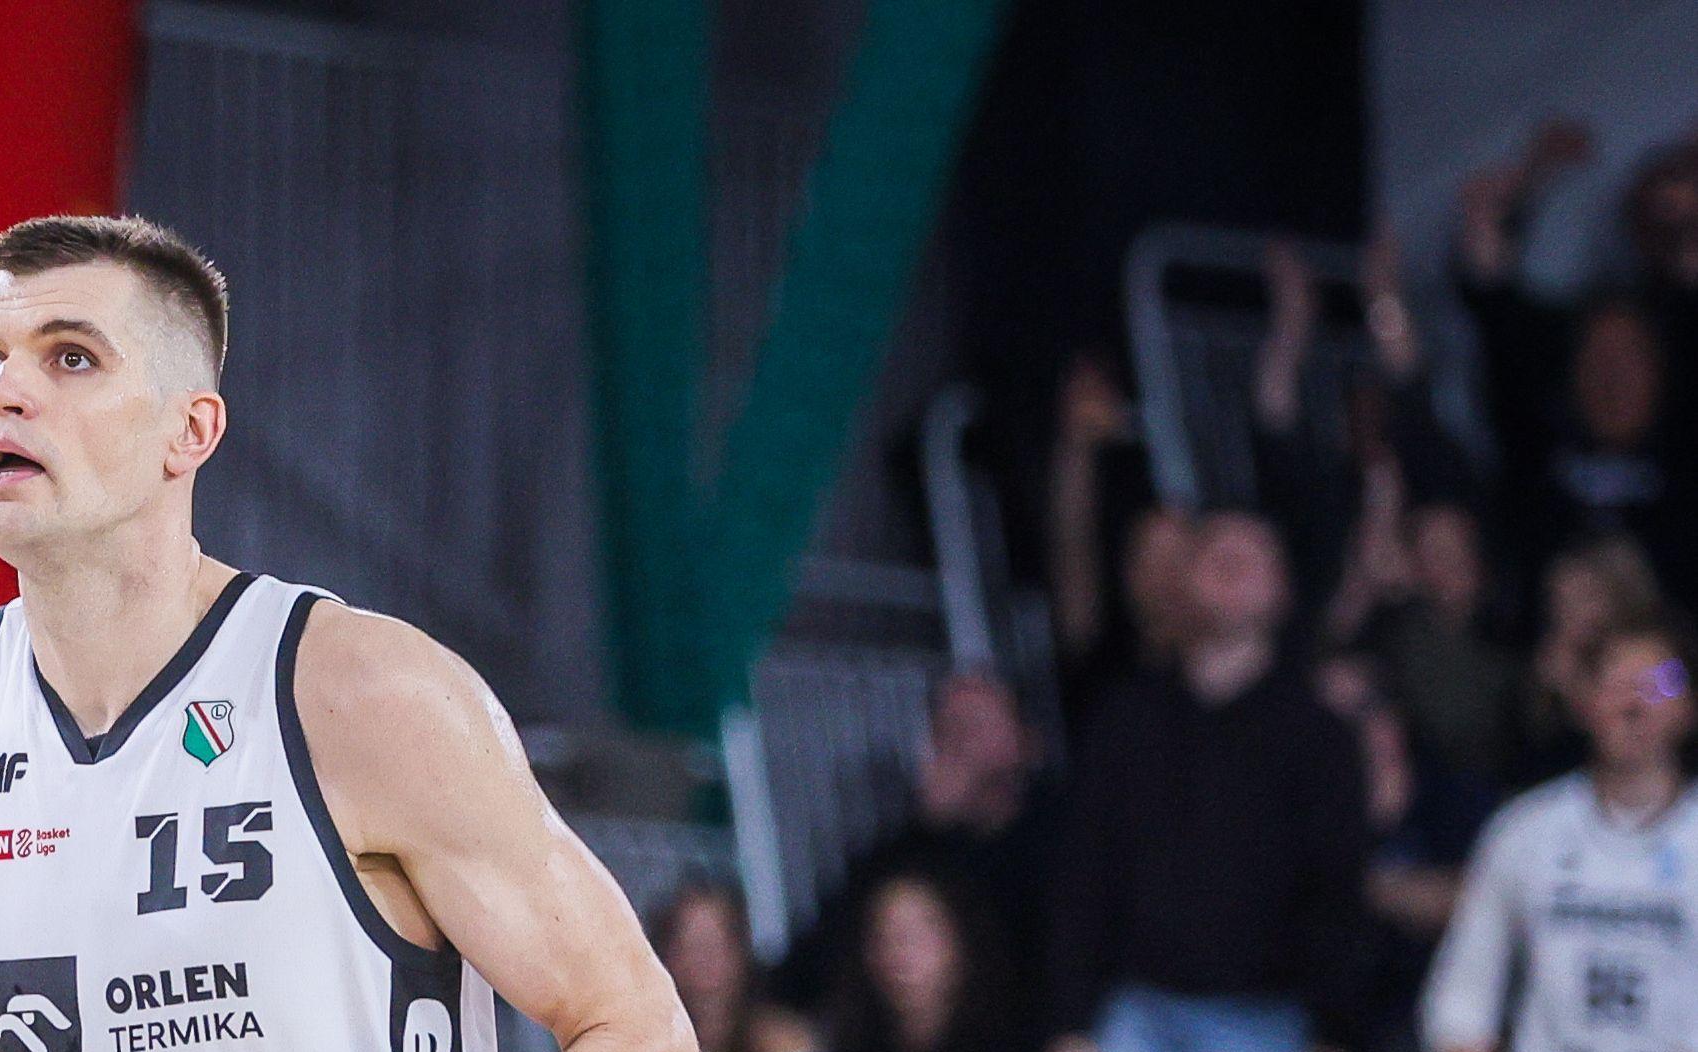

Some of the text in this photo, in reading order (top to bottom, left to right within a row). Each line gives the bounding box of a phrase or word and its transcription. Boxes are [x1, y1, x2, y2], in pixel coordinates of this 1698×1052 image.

[36, 828, 71, 840] Basket
[134, 801, 273, 915] 15
[105, 962, 249, 1014] ORLEN
